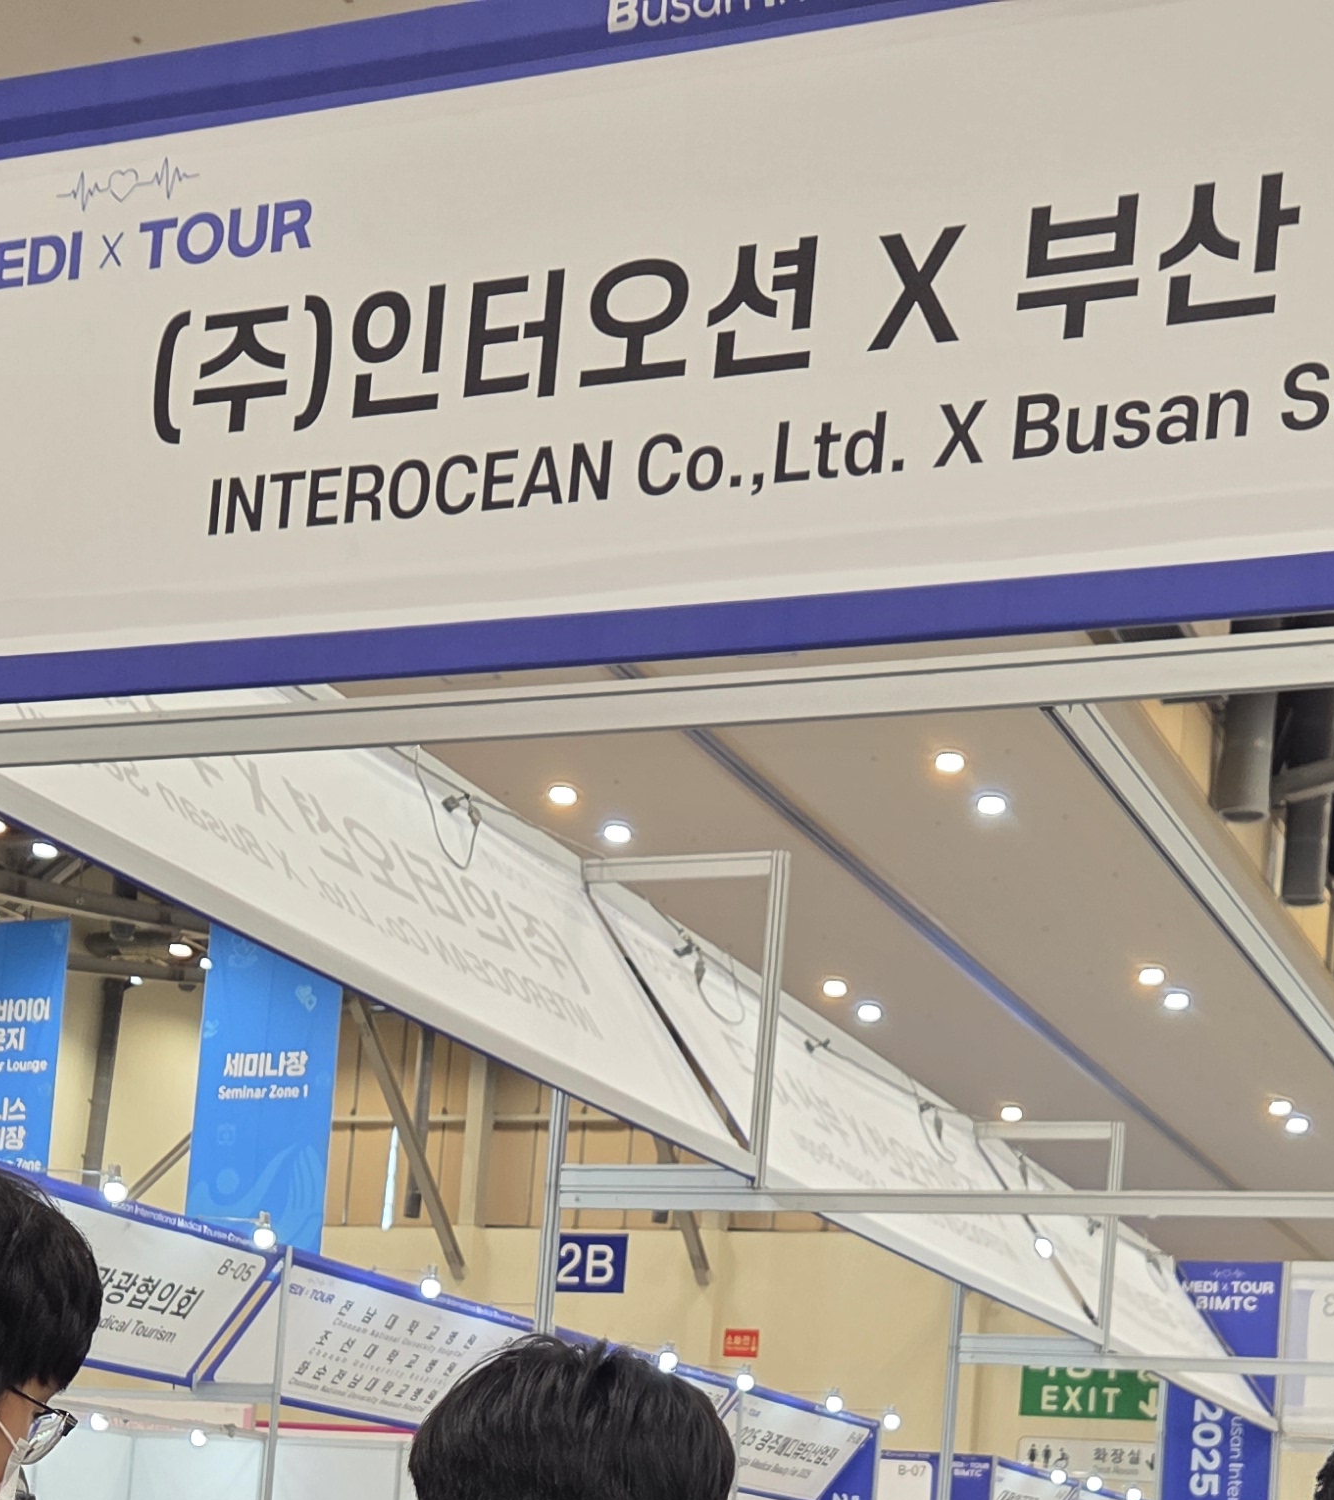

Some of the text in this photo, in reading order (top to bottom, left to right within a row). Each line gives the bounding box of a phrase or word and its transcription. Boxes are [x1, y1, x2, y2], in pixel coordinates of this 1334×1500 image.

[140, 199, 313, 270] TOUR
[153, 235, 819, 443] (주)인터오션
[868, 225, 967, 352] X
[1016, 172, 1300, 340] 부산
[207, 441, 612, 535] INTEROCEAN
[636, 411, 906, 498] Co.,Ltd.
[935, 402, 987, 470] X
[1012, 375, 1251, 461] Busan
[7, 1058, 48, 1075] Lounge
[223, 1050, 308, 1079] 세미나장
[218, 1084, 309, 1100] Seminar Zone 1
[217, 1258, 257, 1283] B-05
[557, 1243, 614, 1286] 2B
[1231, 1280, 1276, 1295] TOUR
[1195, 1295, 1259, 1312] BIMTC
[99, 1314, 177, 1344] dical Tourism
[1040, 1385, 1122, 1414] EXIT
[1189, 1398, 1224, 1498] 2025
[1227, 1414, 1244, 1462] usan
[898, 1464, 927, 1477] B-07
[1092, 1446, 1143, 1467] 화장실
